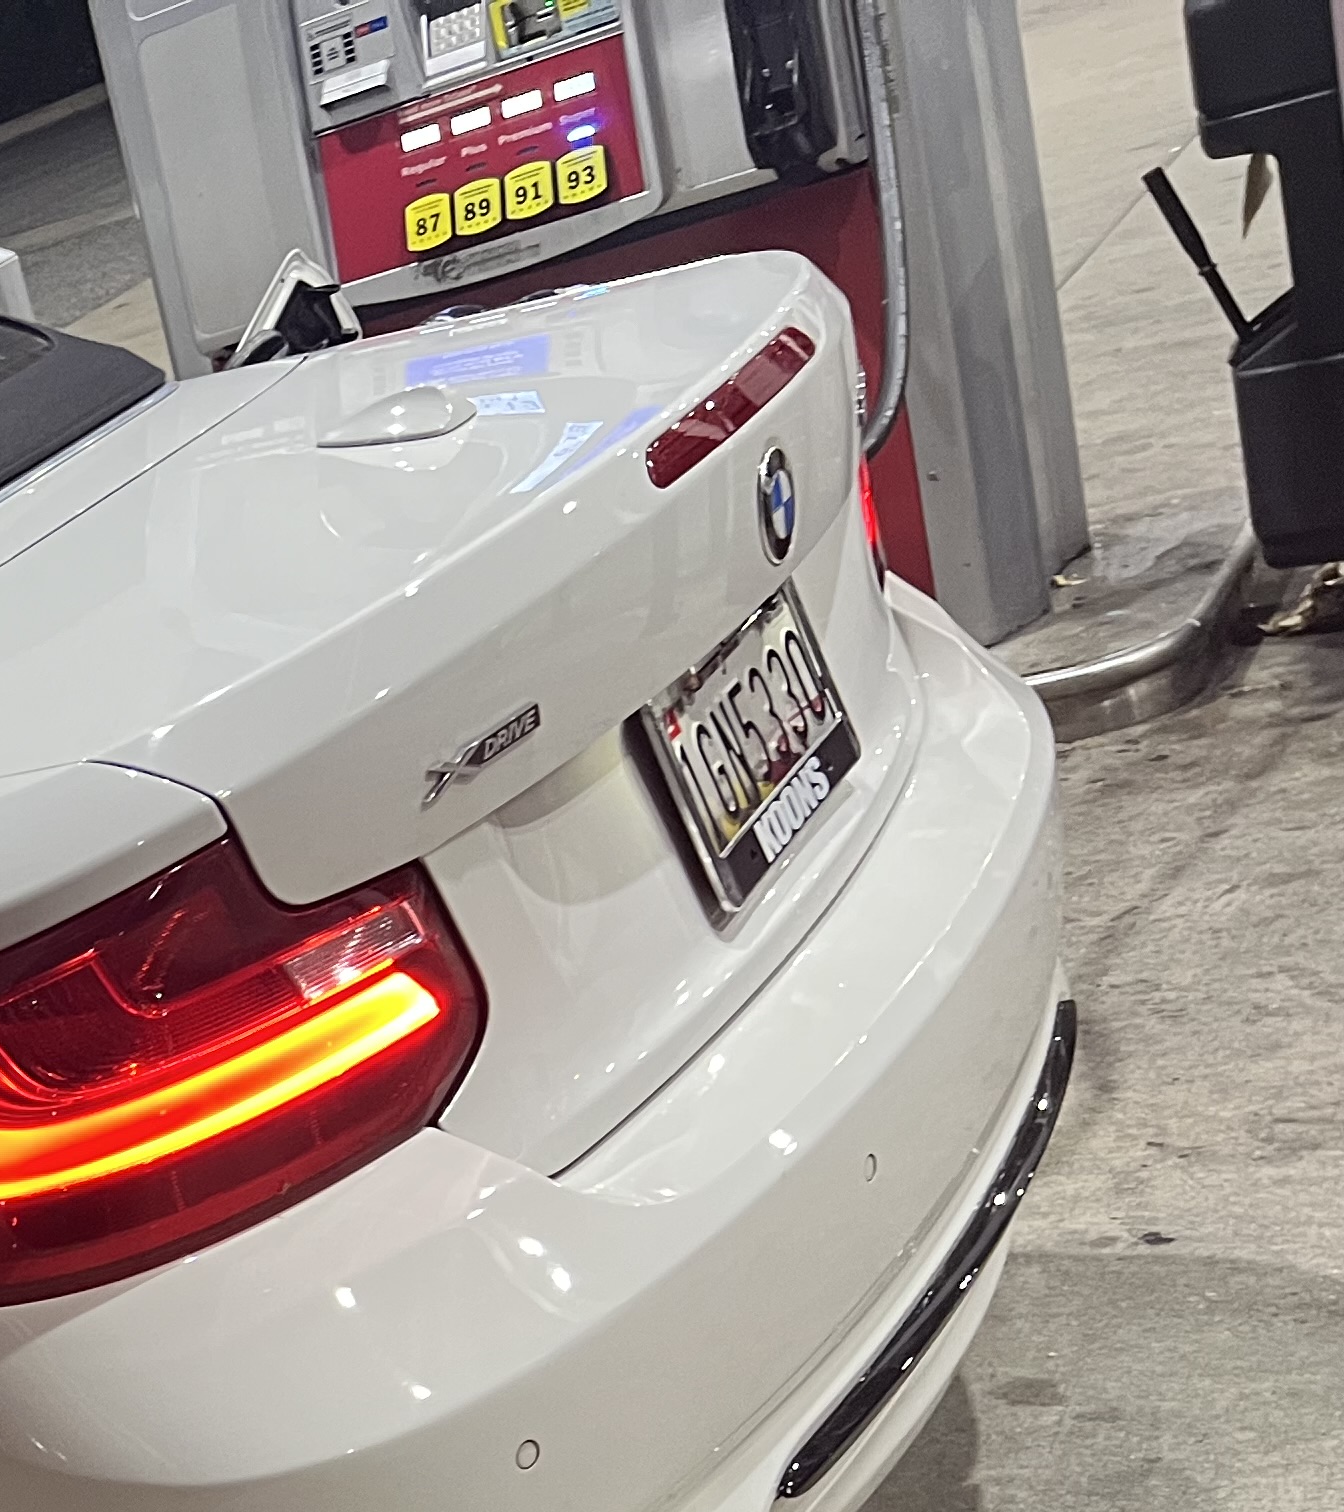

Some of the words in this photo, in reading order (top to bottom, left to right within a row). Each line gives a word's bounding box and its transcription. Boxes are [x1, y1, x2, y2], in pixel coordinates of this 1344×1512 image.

[400, 156, 447, 177] Regular
[567, 165, 596, 190] 93
[515, 181, 543, 205] 91
[464, 198, 491, 222] 89
[416, 212, 441, 237] 87
[678, 628, 826, 851] 1GN5330
[752, 755, 831, 864] KOONS
